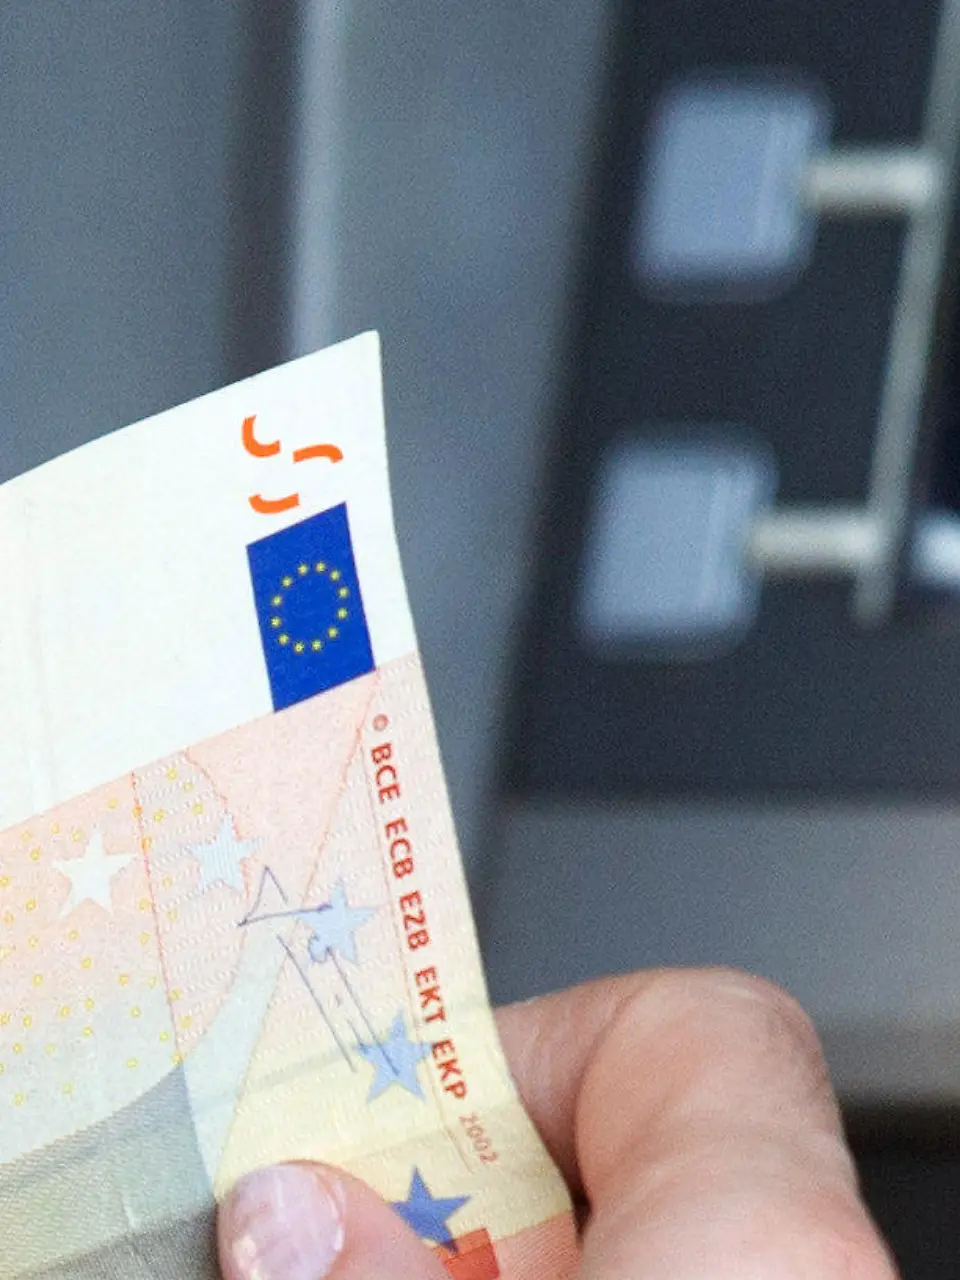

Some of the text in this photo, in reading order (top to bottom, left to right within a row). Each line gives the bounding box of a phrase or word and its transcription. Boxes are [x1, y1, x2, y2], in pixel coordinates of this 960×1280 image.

[370, 742, 401, 804] BCE
[384, 816, 416, 880] ECB
[399, 890, 431, 951] EZB
[413, 964, 447, 1023] EKT
[431, 1037, 468, 1099] EKP
[459, 1111, 500, 1165] 2002
